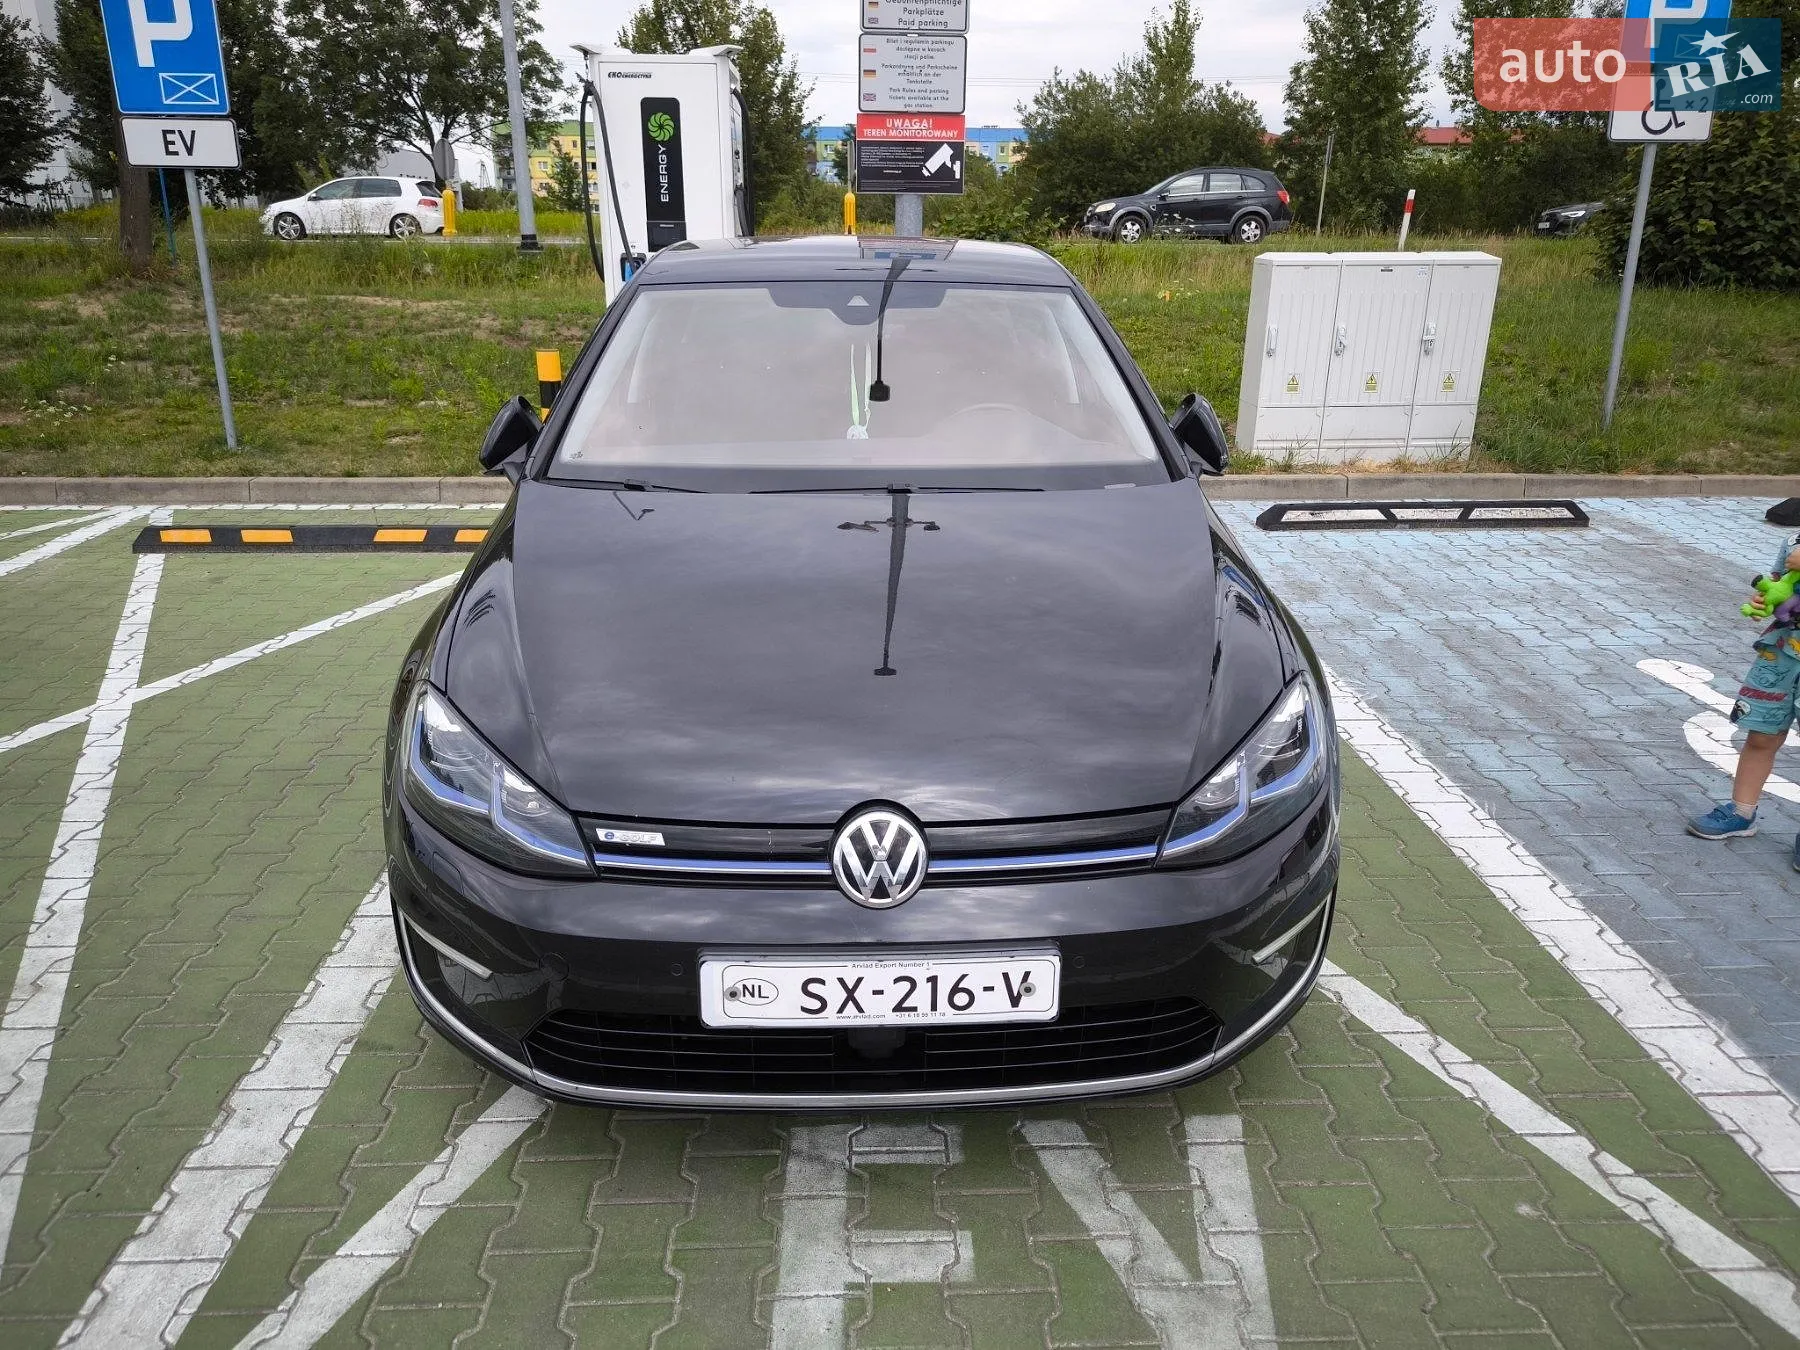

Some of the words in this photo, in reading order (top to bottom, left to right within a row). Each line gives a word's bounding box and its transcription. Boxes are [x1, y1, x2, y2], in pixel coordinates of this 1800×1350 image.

[898, 18, 915, 26] Paid
[918, 19, 949, 28] parking
[129, 0, 193, 68] P
[886, 118, 934, 128] UWAGA!
[863, 128, 887, 137] TEREN
[889, 129, 958, 138] MONITOROWANY
[161, 129, 196, 156] EV
[658, 144, 669, 203] ENERGY
[874, 961, 897, 969] Export
[898, 960, 924, 968] Number
[741, 983, 770, 999] NL
[799, 970, 1032, 1015] SX-216-V
